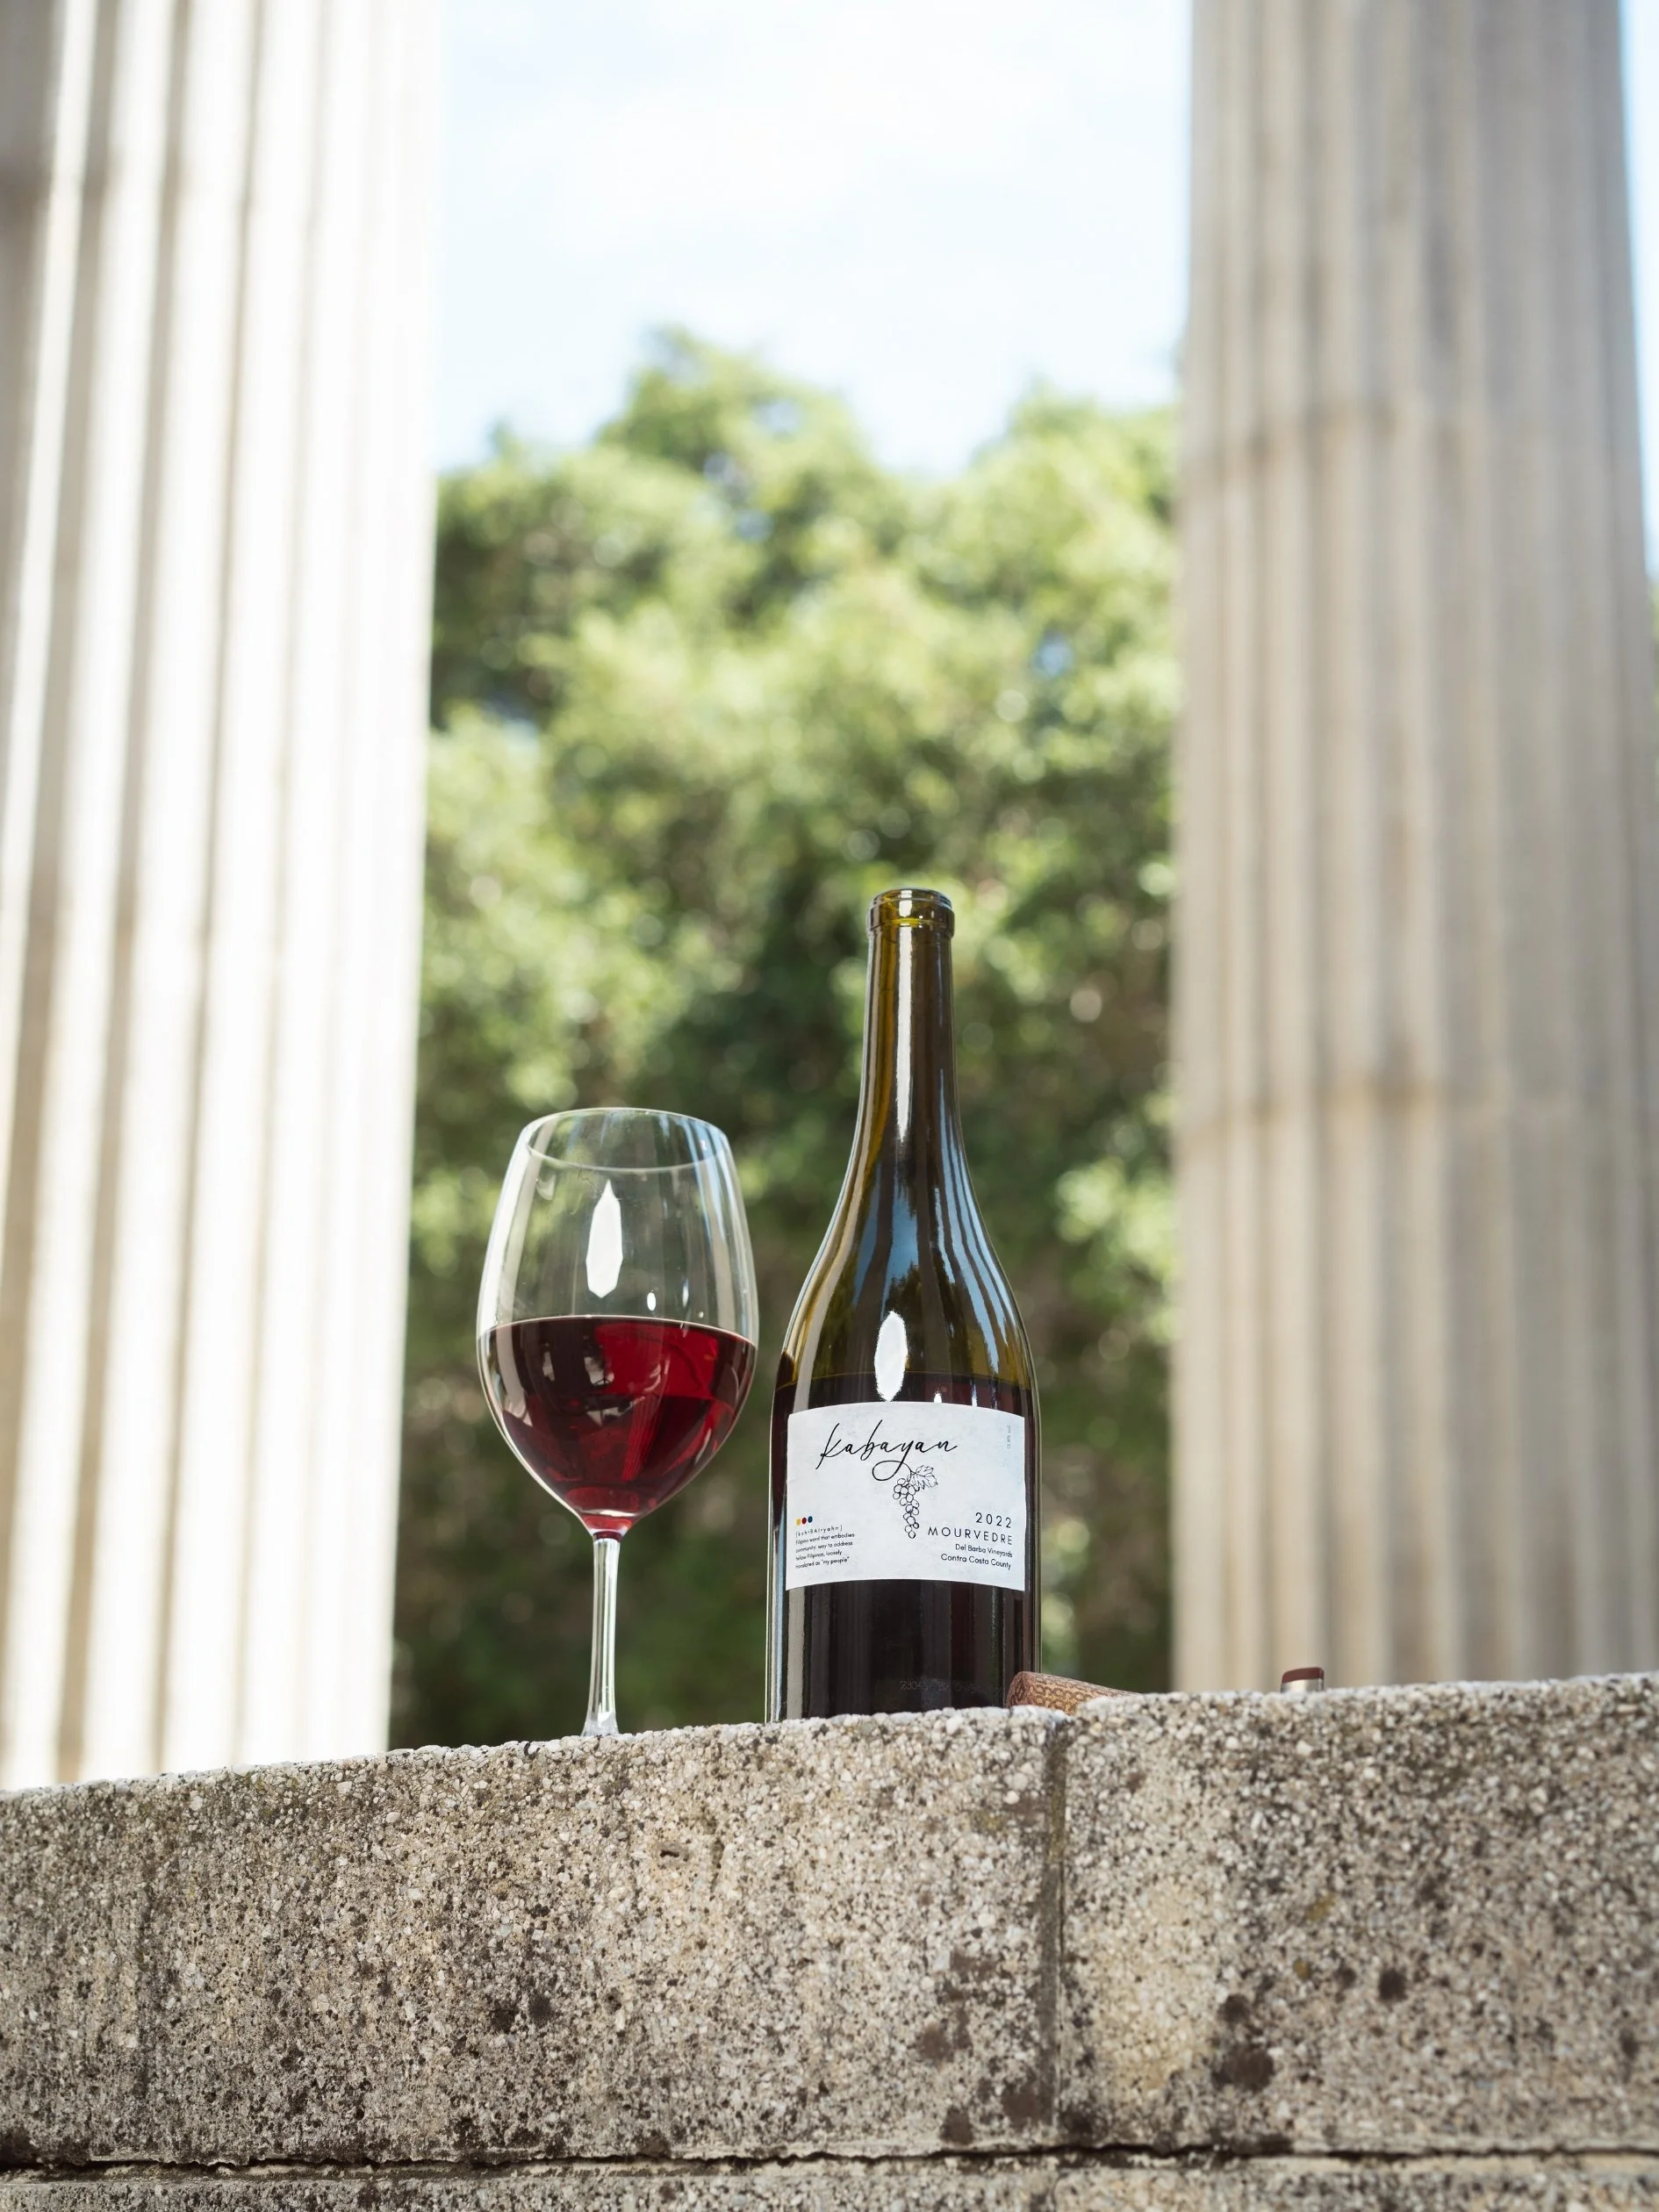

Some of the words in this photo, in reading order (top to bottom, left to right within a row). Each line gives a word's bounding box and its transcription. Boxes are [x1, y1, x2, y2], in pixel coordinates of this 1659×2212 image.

[975, 1512, 1011, 1528] 2022
[927, 1526, 1012, 1545] MOURVEDRE
[968, 1544, 986, 1554] Barba
[987, 1548, 1013, 1558] Vineyards
[940, 1553, 967, 1562] Contra
[968, 1555, 989, 1565] Costa
[990, 1558, 1011, 1570] County
